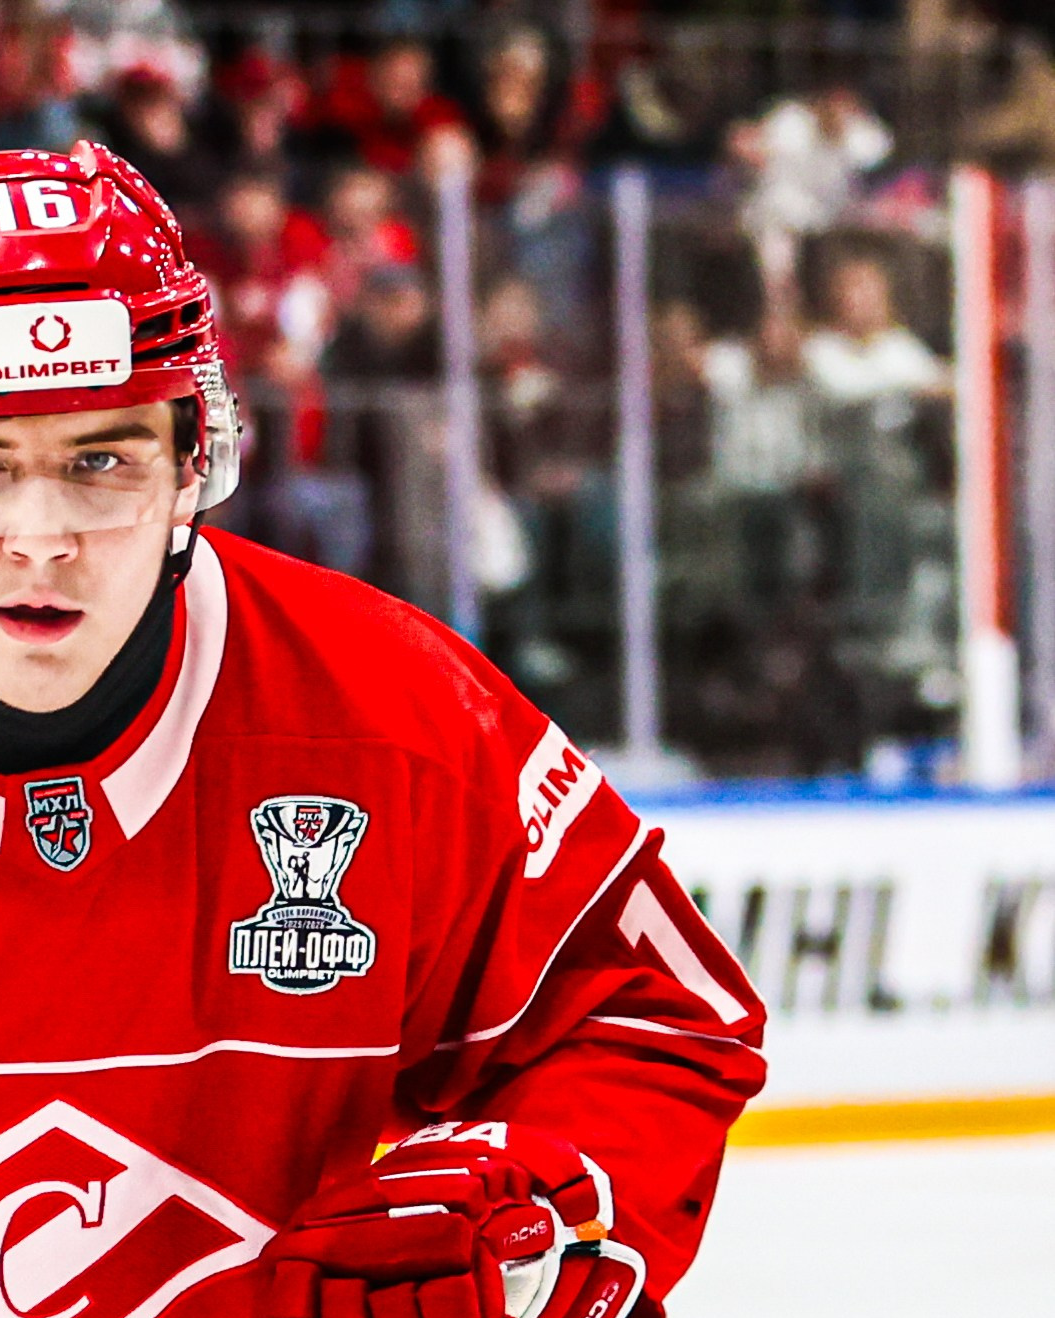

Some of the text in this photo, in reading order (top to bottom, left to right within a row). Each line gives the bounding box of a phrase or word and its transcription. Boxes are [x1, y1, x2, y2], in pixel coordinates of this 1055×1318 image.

[33, 794, 79, 814] МХЛ
[235, 928, 369, 970] ПЛЕЙ-ОФФ
[267, 968, 334, 980] OLIMPBET
